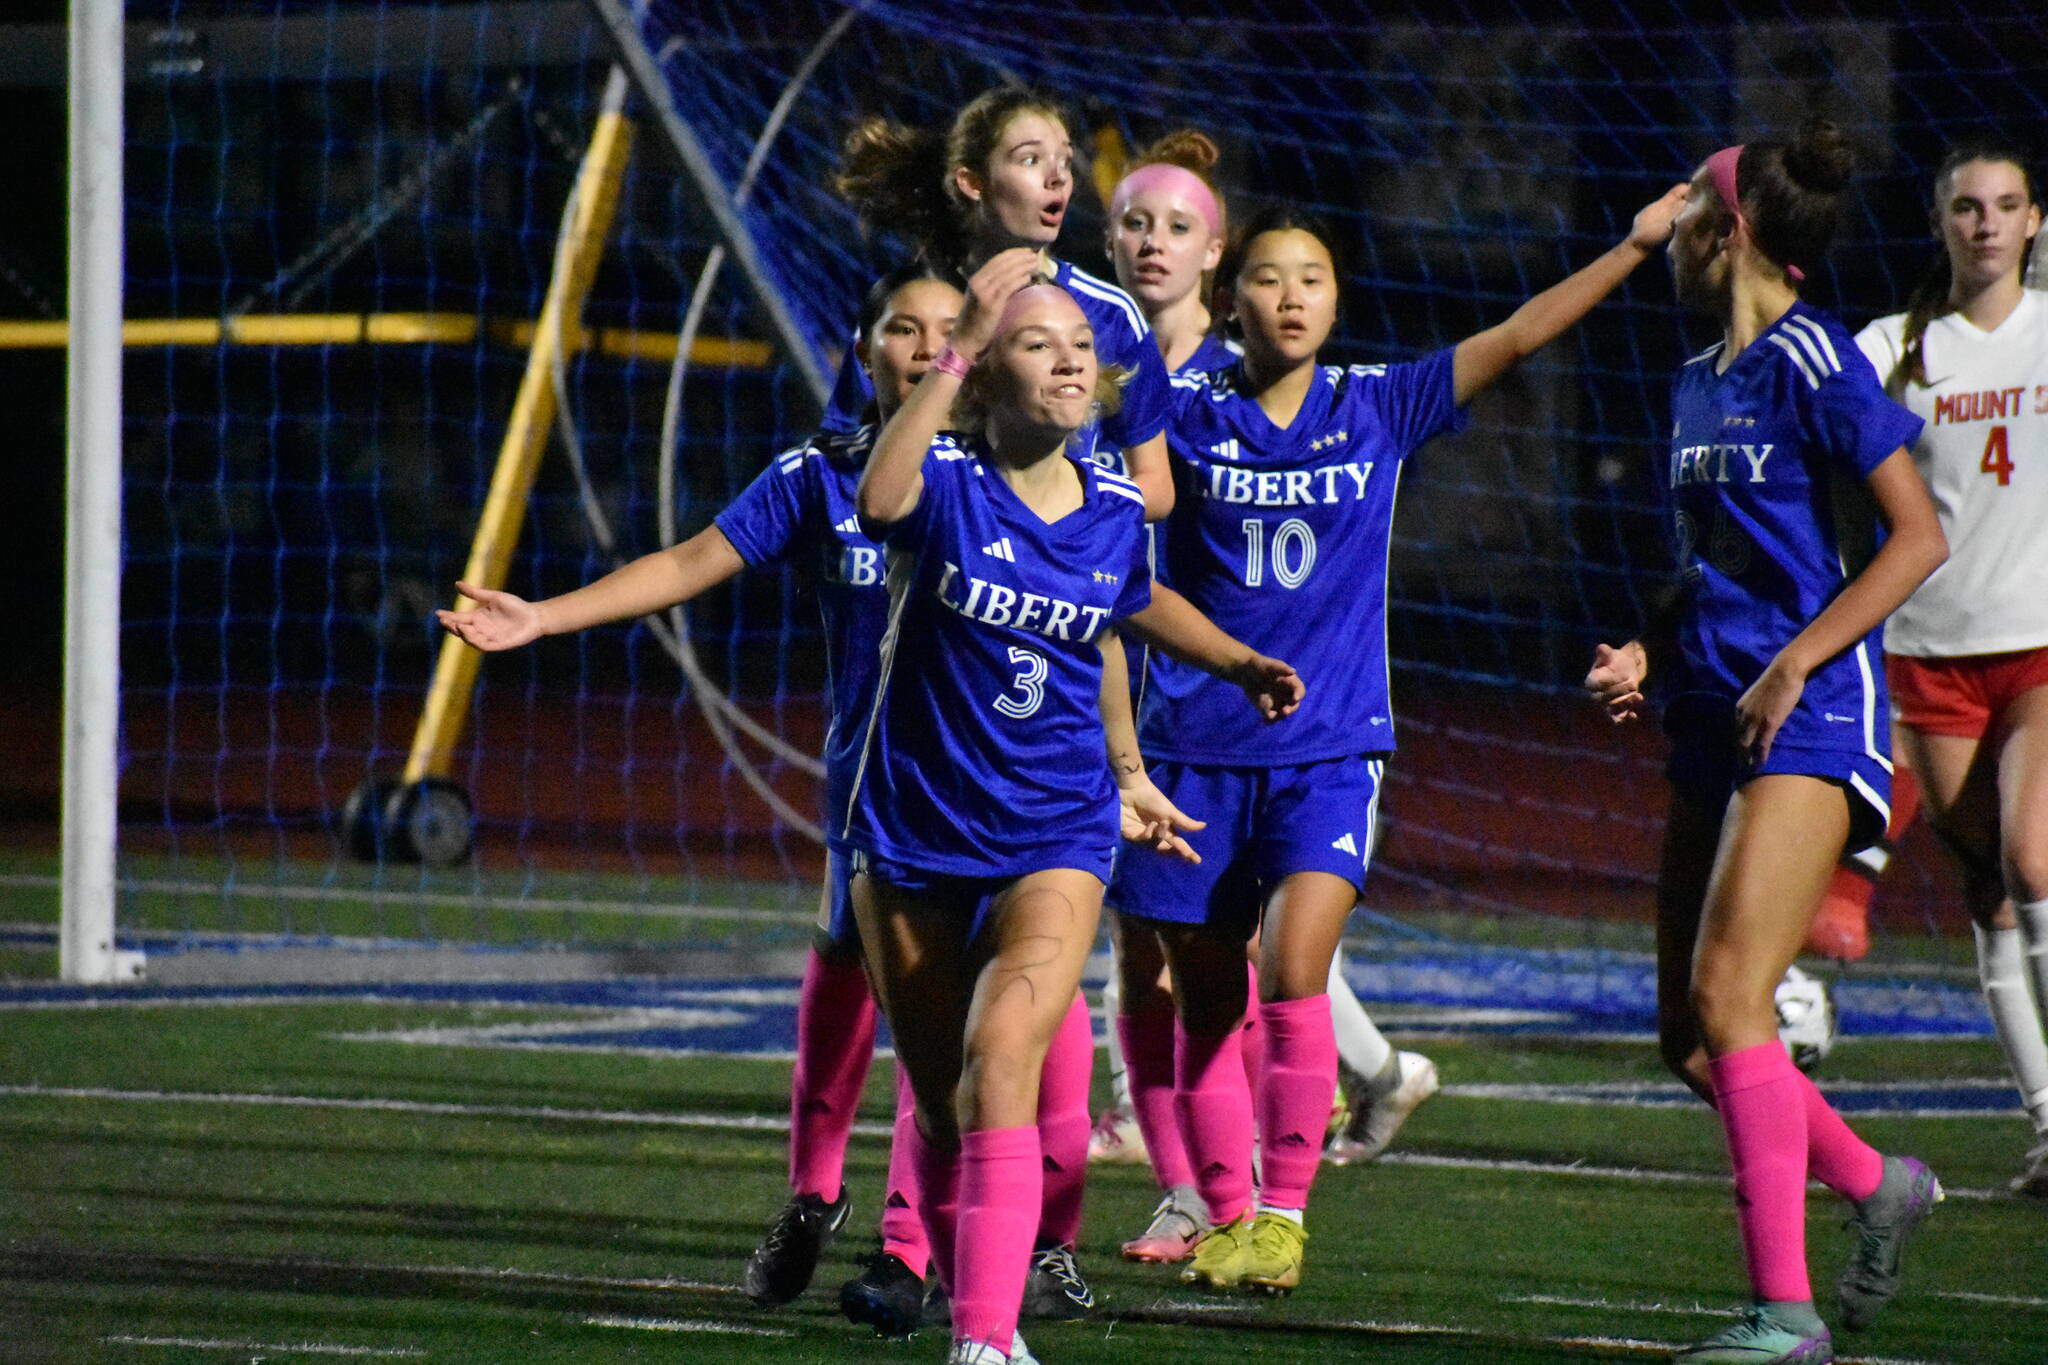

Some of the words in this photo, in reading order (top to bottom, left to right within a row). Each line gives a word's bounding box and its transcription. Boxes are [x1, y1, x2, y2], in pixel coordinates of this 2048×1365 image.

[1933, 387, 2026, 426] MOUNT
[1980, 425, 2016, 487] 4
[1242, 518, 1317, 589] 10
[936, 560, 1113, 644] LIBERT
[992, 646, 1049, 719] 3
